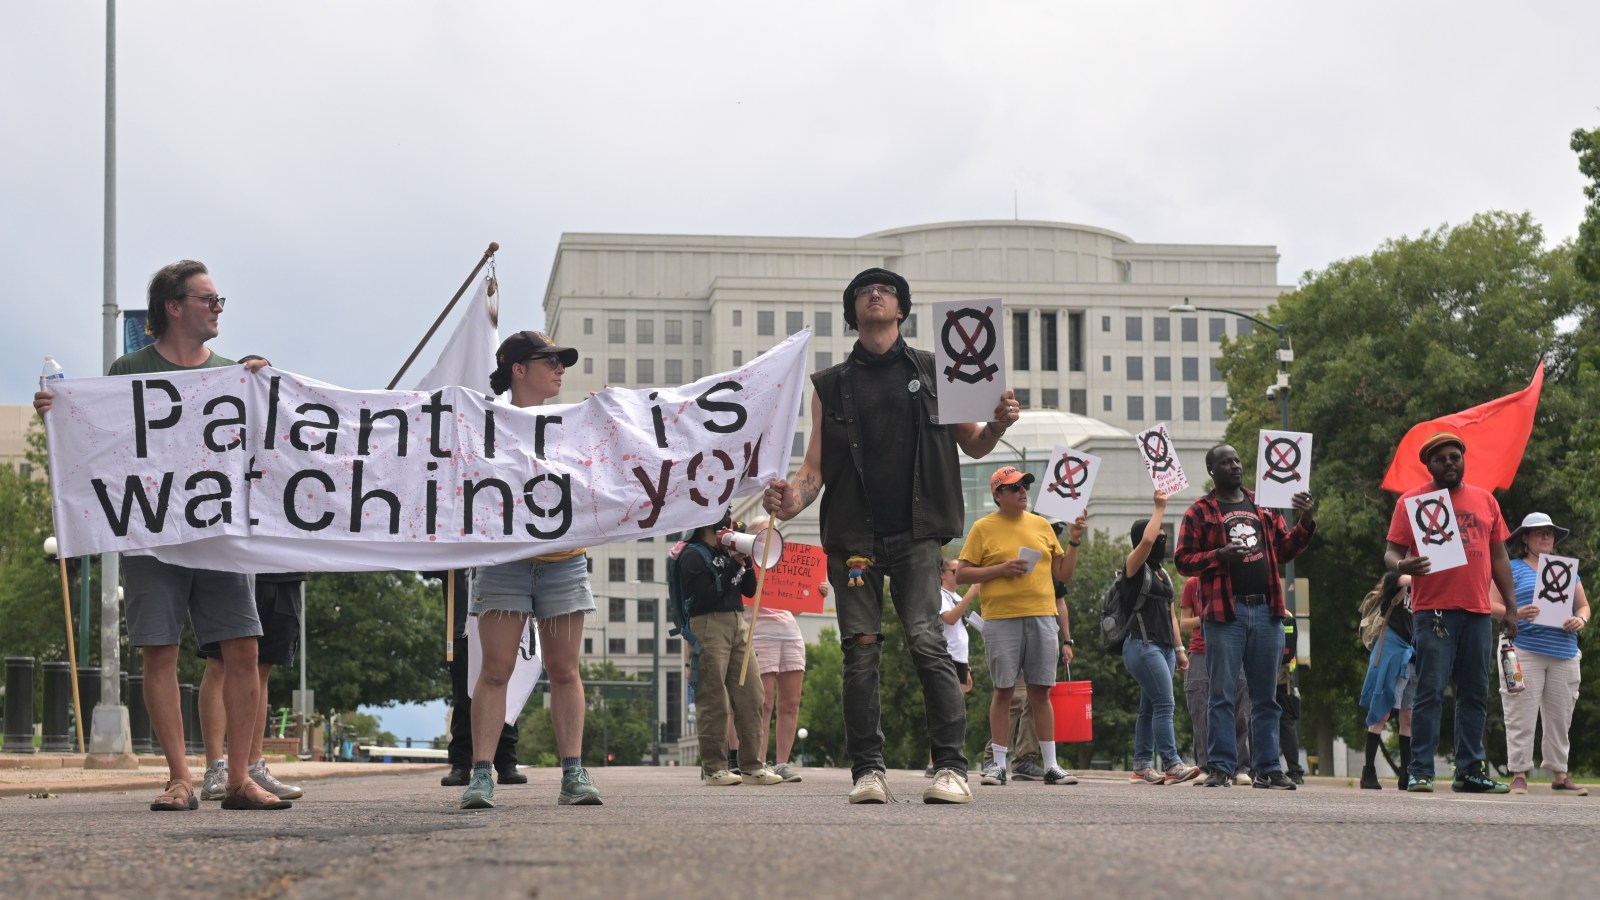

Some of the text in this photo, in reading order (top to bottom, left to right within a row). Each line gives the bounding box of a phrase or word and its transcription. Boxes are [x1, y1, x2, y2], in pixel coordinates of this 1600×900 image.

[131, 376, 748, 459] Palantir is
[91, 455, 573, 539] watching
[765, 563, 812, 578] NETHICAL
[791, 555, 821, 567] GREEDY
